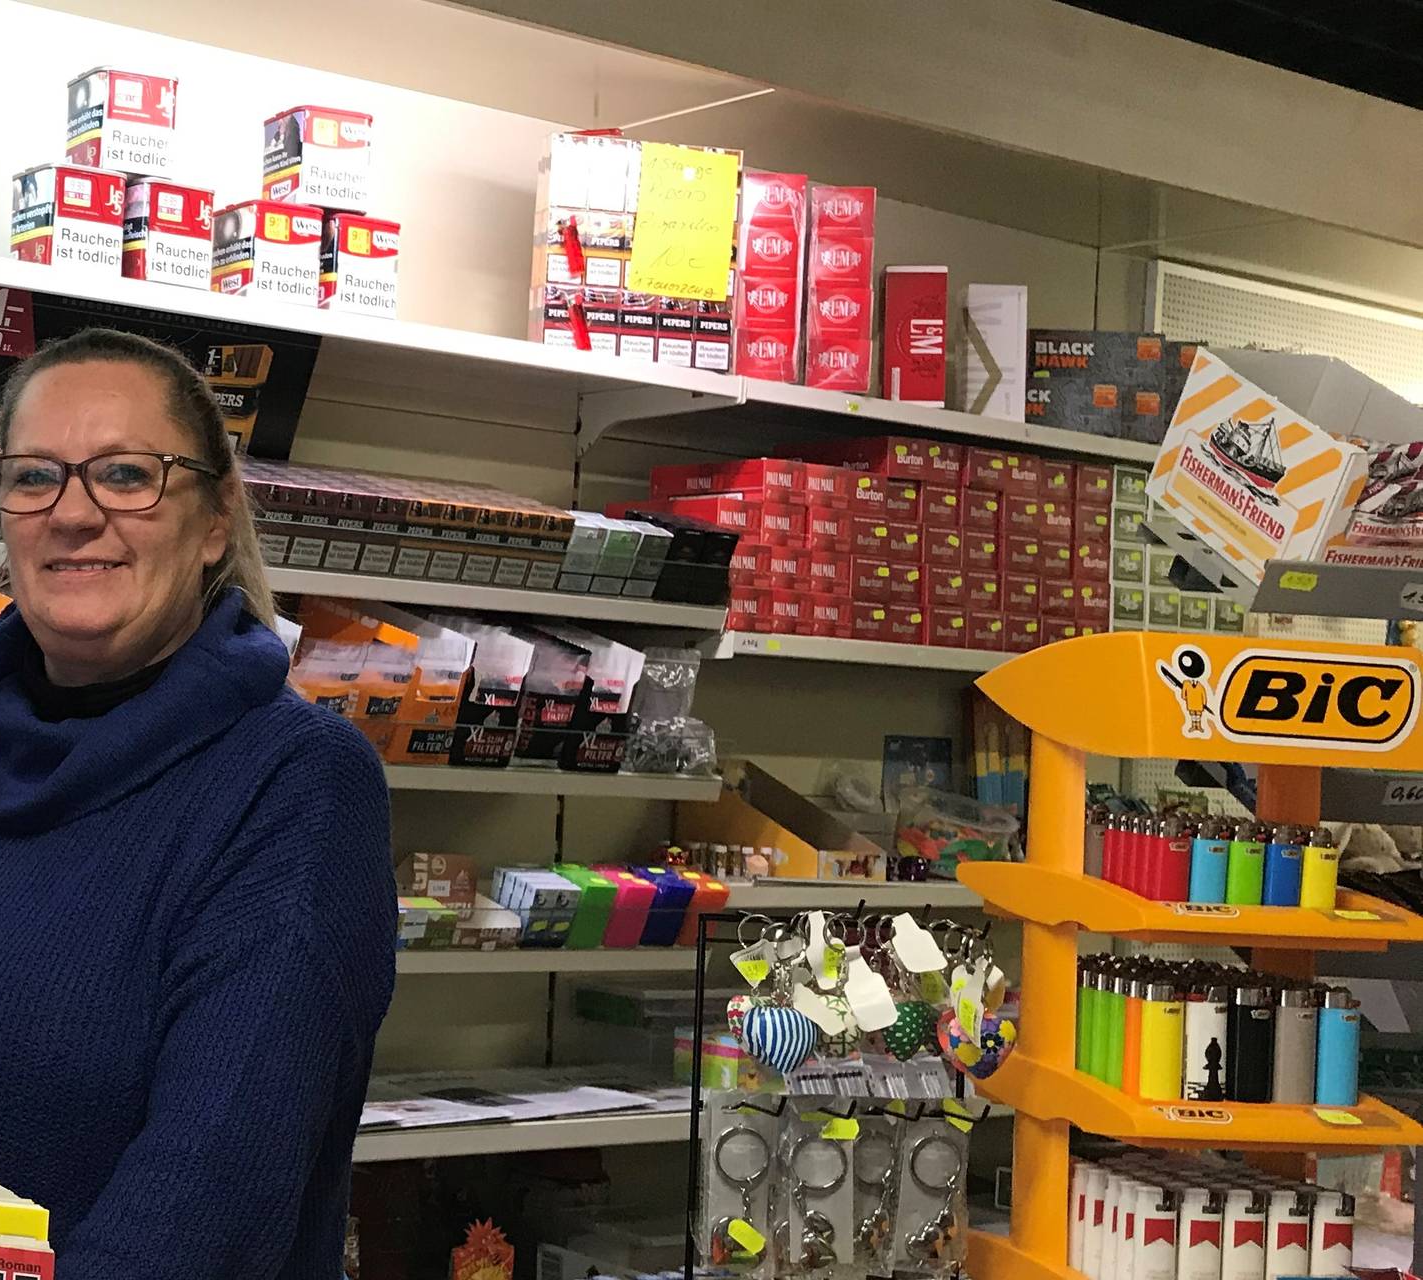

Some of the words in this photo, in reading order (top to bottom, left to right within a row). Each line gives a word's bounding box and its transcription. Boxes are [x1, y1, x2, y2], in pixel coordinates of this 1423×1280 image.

[61, 227, 120, 248] Rauchen
[56, 244, 74, 259] ist
[155, 242, 210, 262] Rauchen
[151, 259, 167, 273] ist
[261, 261, 317, 280] Rauchen
[256, 277, 273, 291] ist
[344, 274, 396, 293] Rauchen
[340, 291, 355, 305] ist
[586, 310, 616, 322] PIPERS
[624, 313, 653, 325] PIPERS
[662, 316, 691, 328] PIPERS
[699, 320, 728, 331] PIPERS
[910, 318, 944, 355] L&M
[1035, 341, 1095, 357] BLACK
[1035, 354, 1089, 369] HAWK
[214, 392, 245, 408] PERS
[896, 453, 924, 466] Burton
[933, 456, 960, 471] Burton
[856, 487, 884, 502] Burton
[1179, 446, 1244, 515] FISHERMAN'S
[1240, 495, 1286, 542] FRIEND
[1325, 550, 1400, 567] FISHERMAN'S
[466, 725, 486, 743] XL
[412, 740, 442, 752] FILTER
